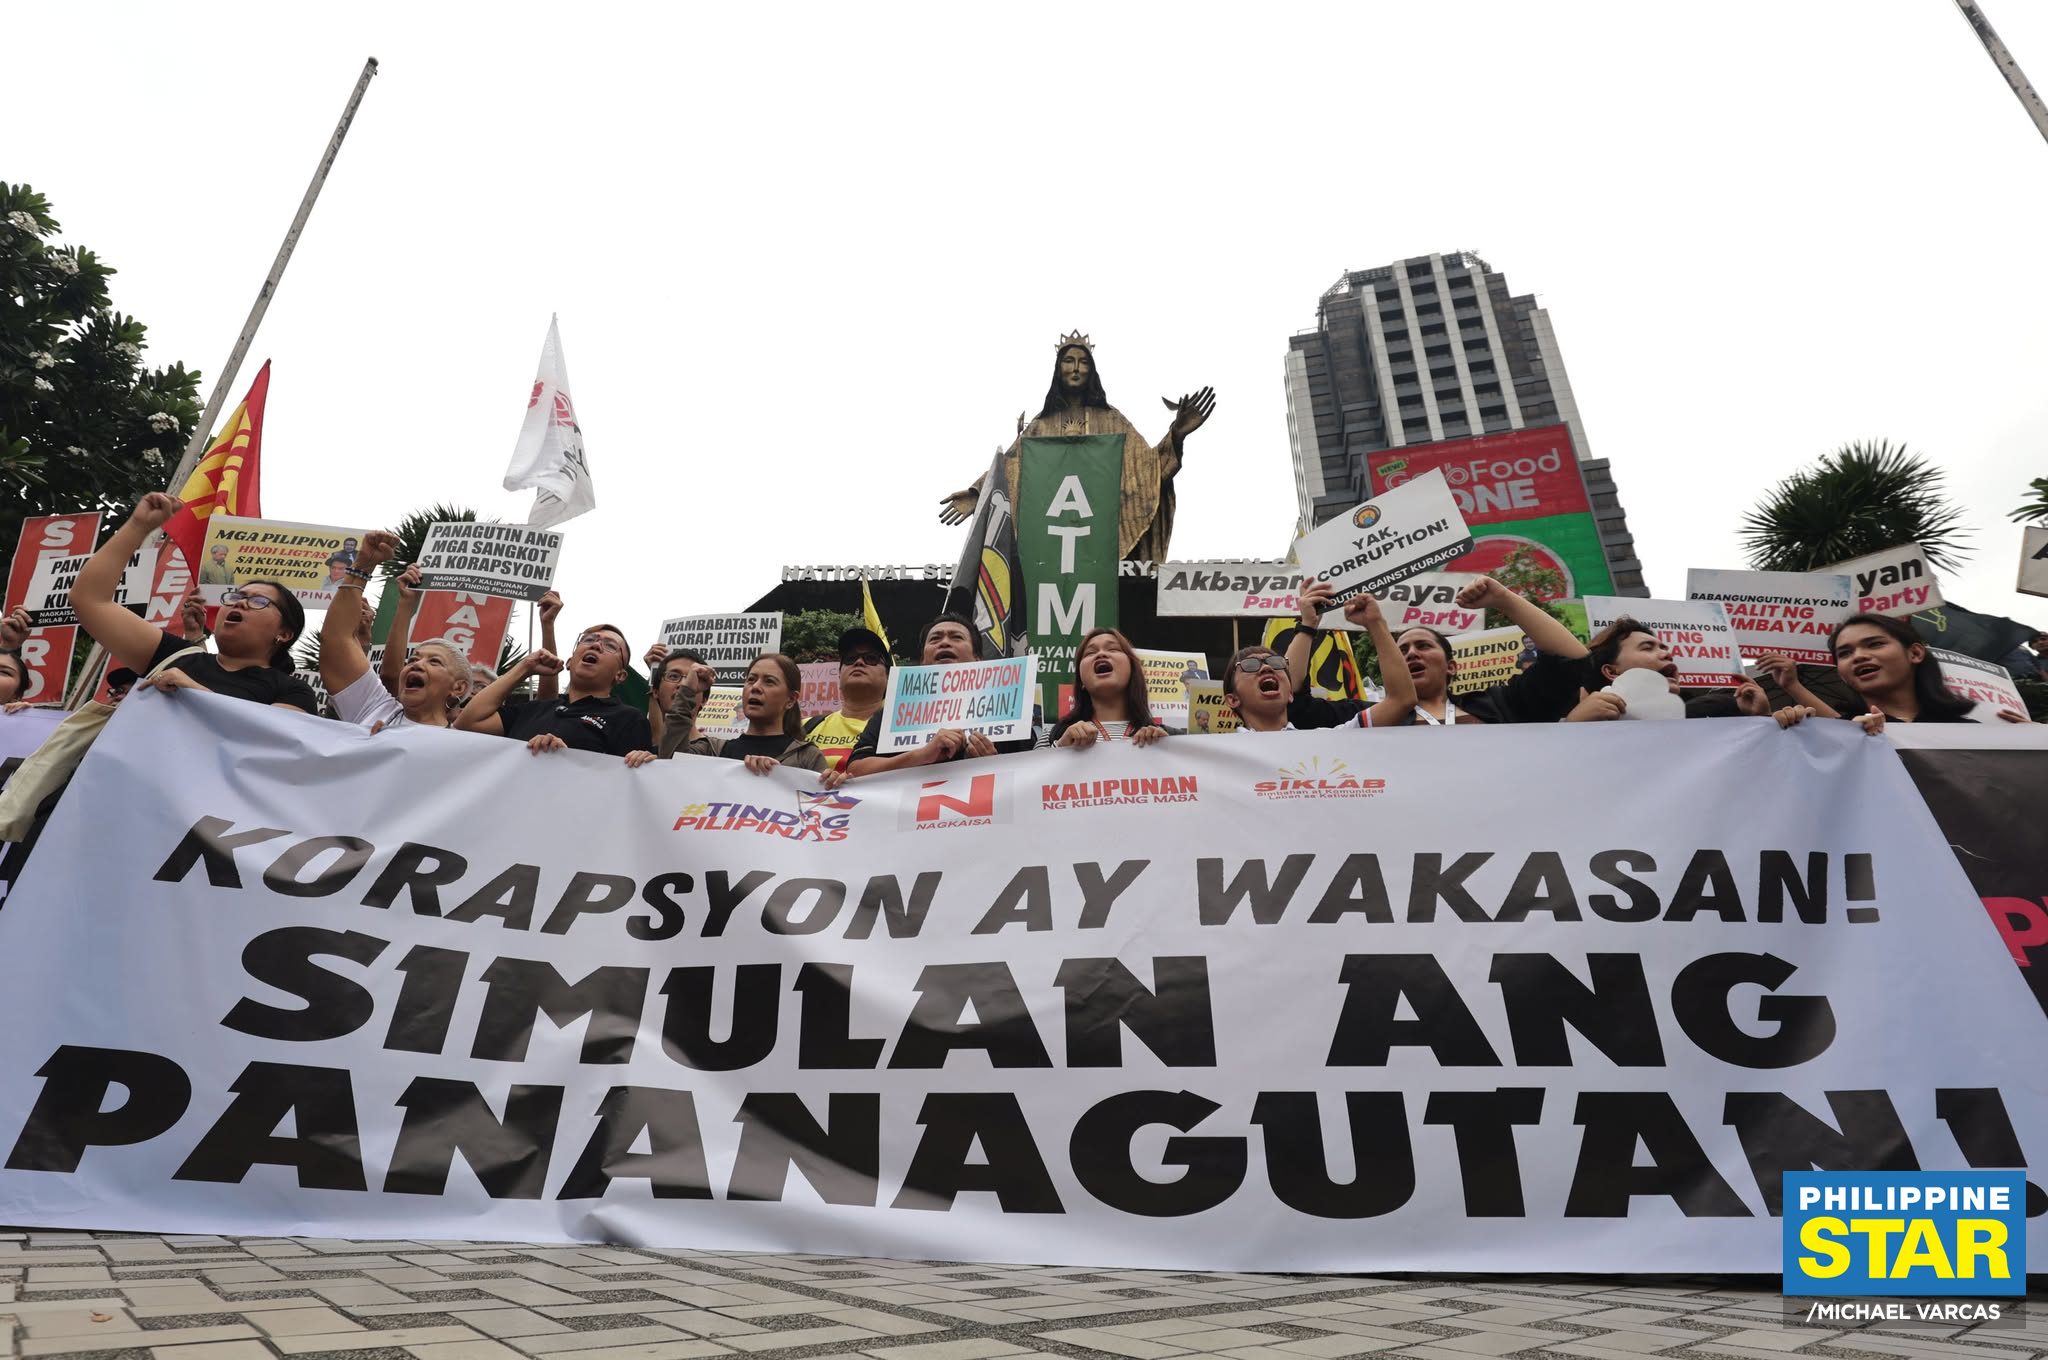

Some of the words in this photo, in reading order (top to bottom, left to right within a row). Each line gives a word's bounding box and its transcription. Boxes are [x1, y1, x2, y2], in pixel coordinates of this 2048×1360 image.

[215, 529, 259, 542] MGA
[260, 534, 340, 549] PILIPINO
[431, 525, 522, 545] PANAGUTIN
[524, 531, 559, 548] ANG
[1352, 526, 1398, 550] YAK,
[238, 545, 277, 555] HINDI
[279, 549, 329, 559] LIGTAS
[431, 540, 468, 553] MGA
[471, 543, 550, 563] SANGKOT
[1317, 518, 1449, 582] CORRUPTION!
[235, 556, 255, 564] SA
[256, 557, 323, 569] KURAKOT
[421, 555, 441, 568] SA
[444, 555, 551, 581] KORAPSYON!
[1361, 569, 1408, 593] AGAINST
[1410, 544, 1465, 572] KURAKOT
[233, 566, 253, 575] NA
[254, 567, 319, 579] PULITIKO
[781, 564, 914, 581] NATIONAL
[433, 575, 471, 583] NAGKAISA
[478, 579, 523, 590] KALIPUNAN
[464, 583, 490, 591] TINDIG
[491, 587, 528, 597] PILIPINAS
[1691, 592, 1793, 605] BABANGUNGUTIN
[1794, 598, 1828, 606] KAYO
[1830, 599, 1849, 608] NG
[1858, 585, 1930, 614] Party
[1402, 608, 1477, 630] Party
[1782, 606, 1815, 619] NG
[664, 618, 757, 633] MAMBABATAS
[759, 618, 778, 629] NA
[1682, 624, 1712, 632] KAYO
[668, 633, 713, 646] KORAP,
[717, 632, 770, 643] LITISIN!
[1677, 631, 1704, 644] NG
[1470, 656, 1514, 669] LIGTAS
[901, 672, 940, 697] MAKE
[941, 663, 1022, 694] CORRUPTION
[895, 698, 961, 727] SHAMEFUL
[965, 687, 1018, 720] AGAIN!
[894, 735, 920, 746] ML
[1042, 776, 1197, 801] KALIPUNAN
[1254, 778, 1386, 793] SIKLAB
[1043, 801, 1068, 810] NG
[1072, 796, 1149, 808] KILUSANG
[1153, 794, 1199, 803] MASA
[916, 818, 993, 831] NAGKAISA
[153, 815, 938, 941] KORAPSYON
[972, 858, 1151, 934] AY
[1196, 849, 1881, 926] WAKASAN!
[220, 926, 1217, 1071] SIMULAN
[1325, 951, 1837, 1070] ANG
